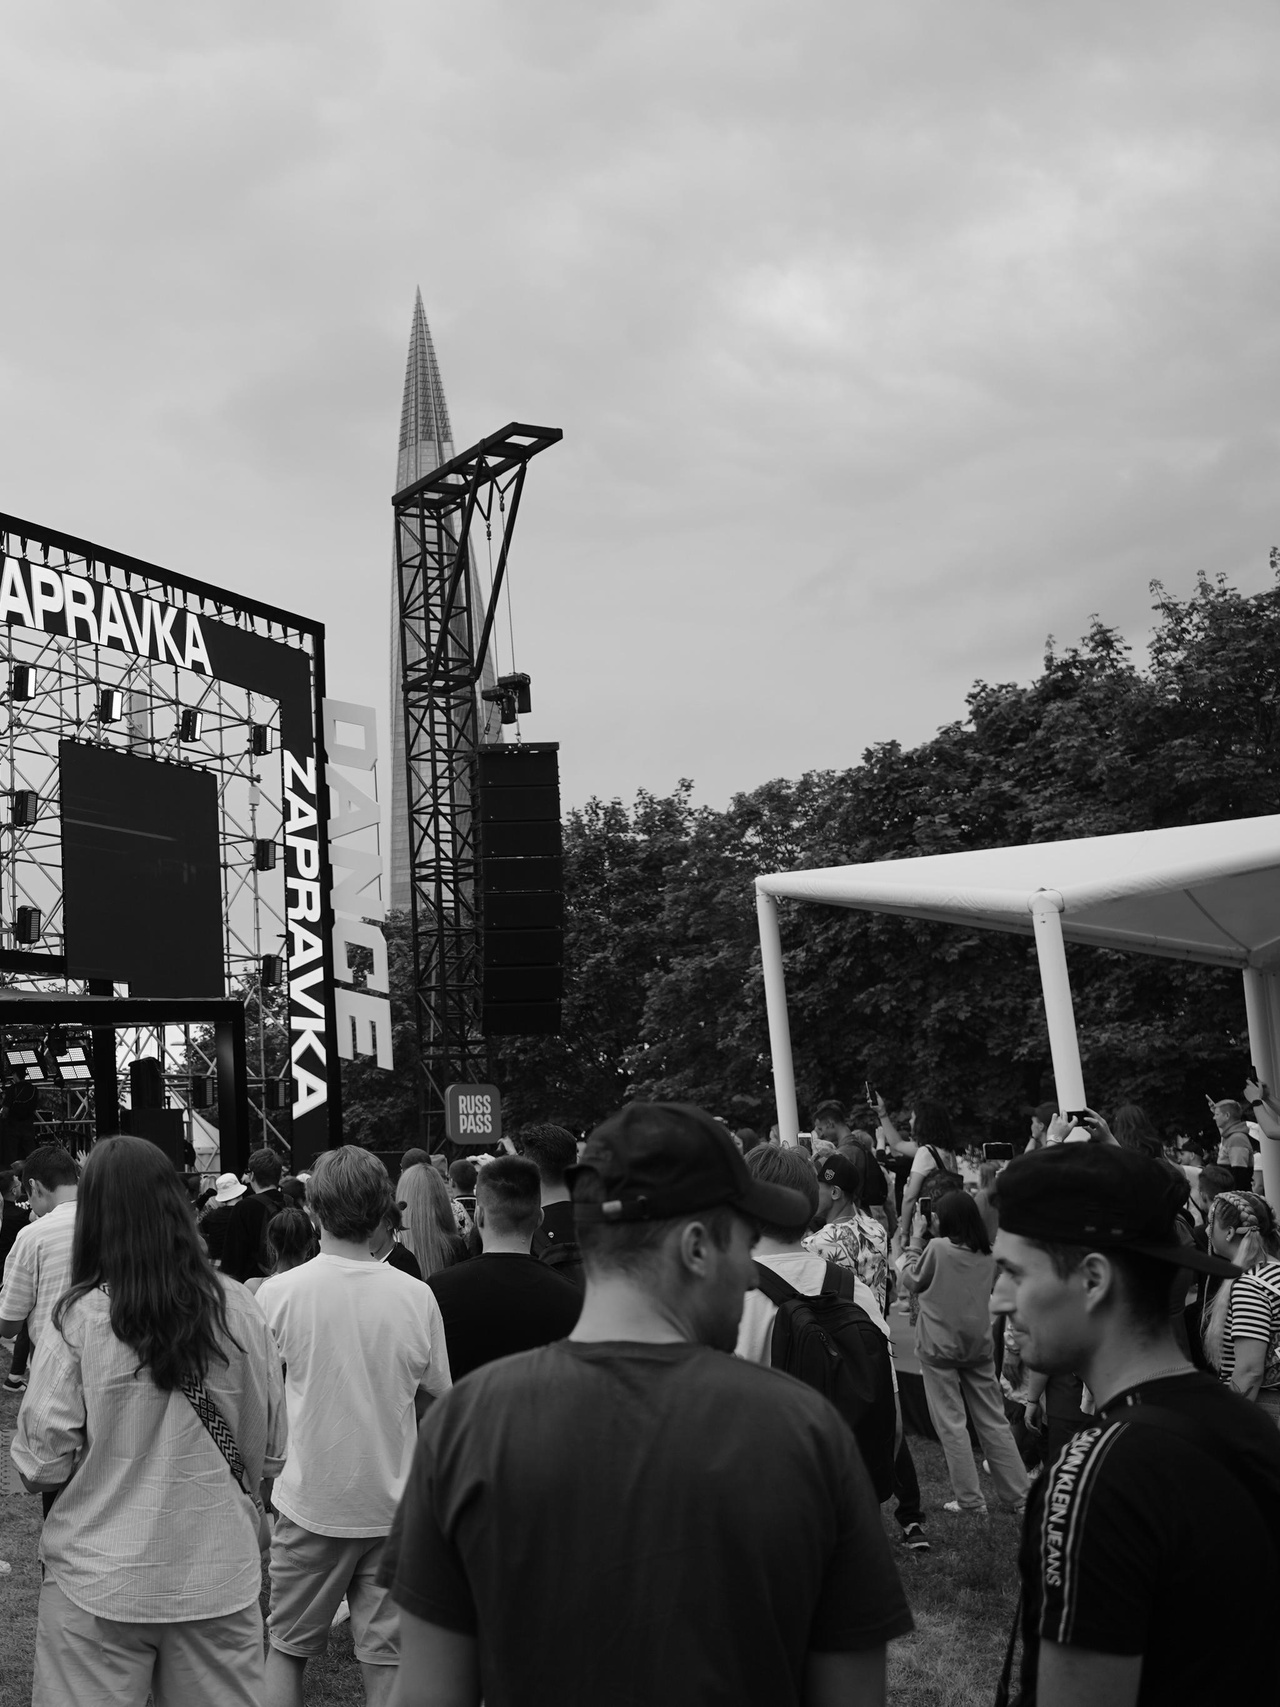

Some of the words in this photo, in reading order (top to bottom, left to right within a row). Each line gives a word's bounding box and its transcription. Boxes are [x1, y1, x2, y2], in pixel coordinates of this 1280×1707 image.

[322, 697, 394, 1071] DANCE
[283, 750, 328, 1120] ZAPRAVKA
[459, 1095, 491, 1114] RUSS
[460, 1114, 492, 1134] PASS
[1049, 1472, 1077, 1525] KLEIN
[1046, 1523, 1063, 1587] JEANS
